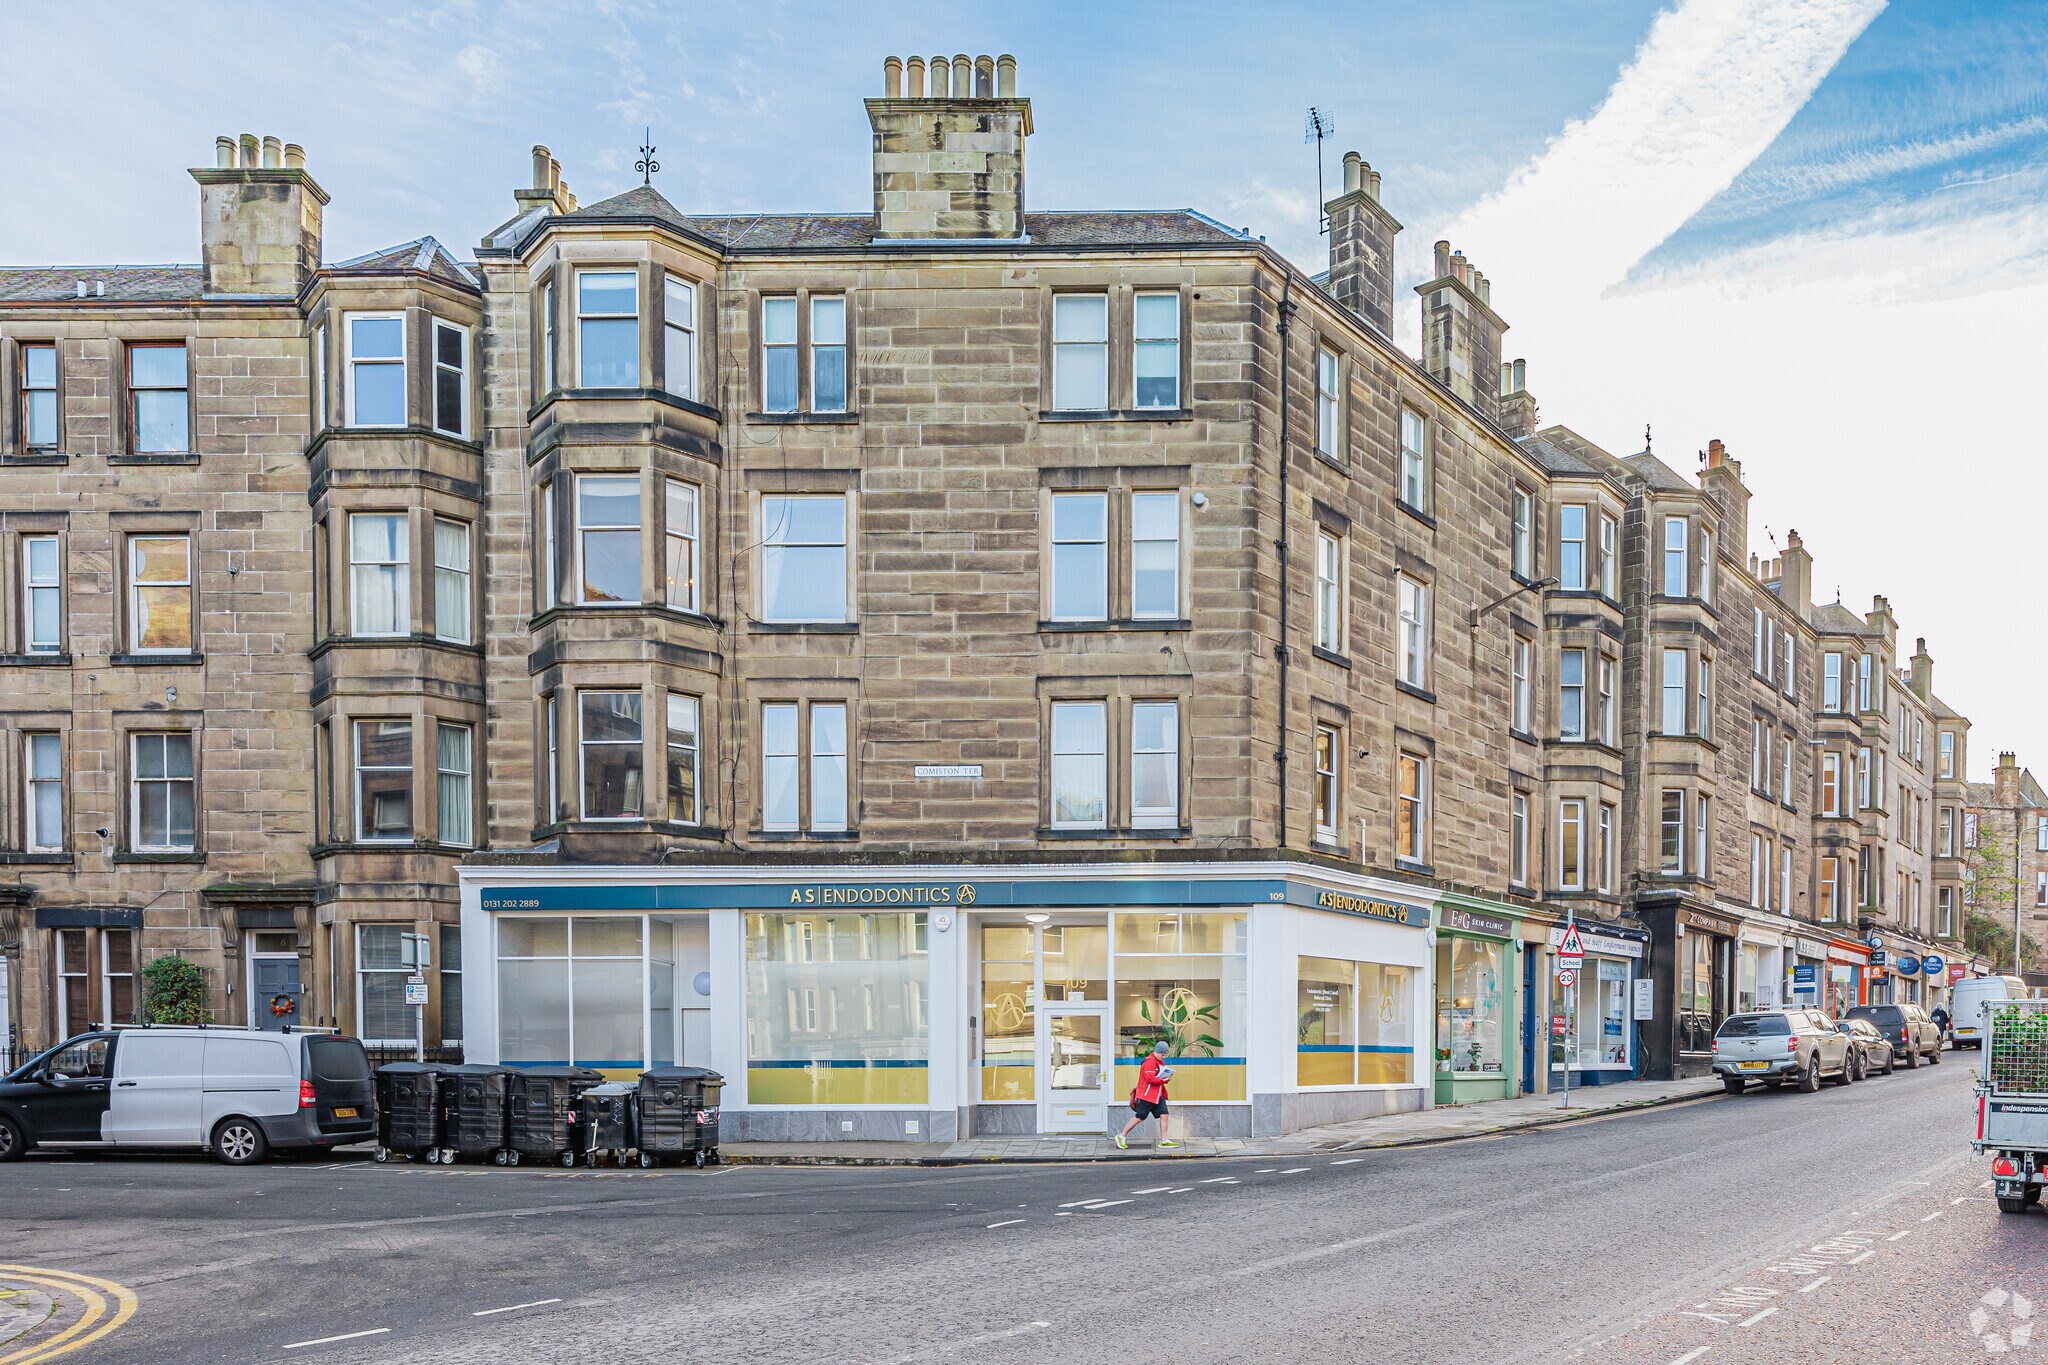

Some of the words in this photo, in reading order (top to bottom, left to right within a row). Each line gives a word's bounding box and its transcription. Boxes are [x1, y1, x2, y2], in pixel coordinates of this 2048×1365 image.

[918, 767, 960, 775] COMISTON
[964, 767, 979, 775] TER
[823, 887, 951, 903] ENDODONTICS
[1269, 892, 1285, 901] 109
[483, 900, 501, 908] 0131
[502, 900, 518, 908] 202
[519, 900, 540, 908] 2889
[1337, 895, 1397, 919] ENDODONTICS
[1471, 918, 1485, 927] SKIN
[1485, 921, 1504, 931] CLINIC
[280, 938, 287, 947] 8
[1603, 941, 1627, 953] Employment
[1627, 944, 1642, 956] Agency
[1561, 974, 1573, 982] 20
[1066, 978, 1088, 989] 109
